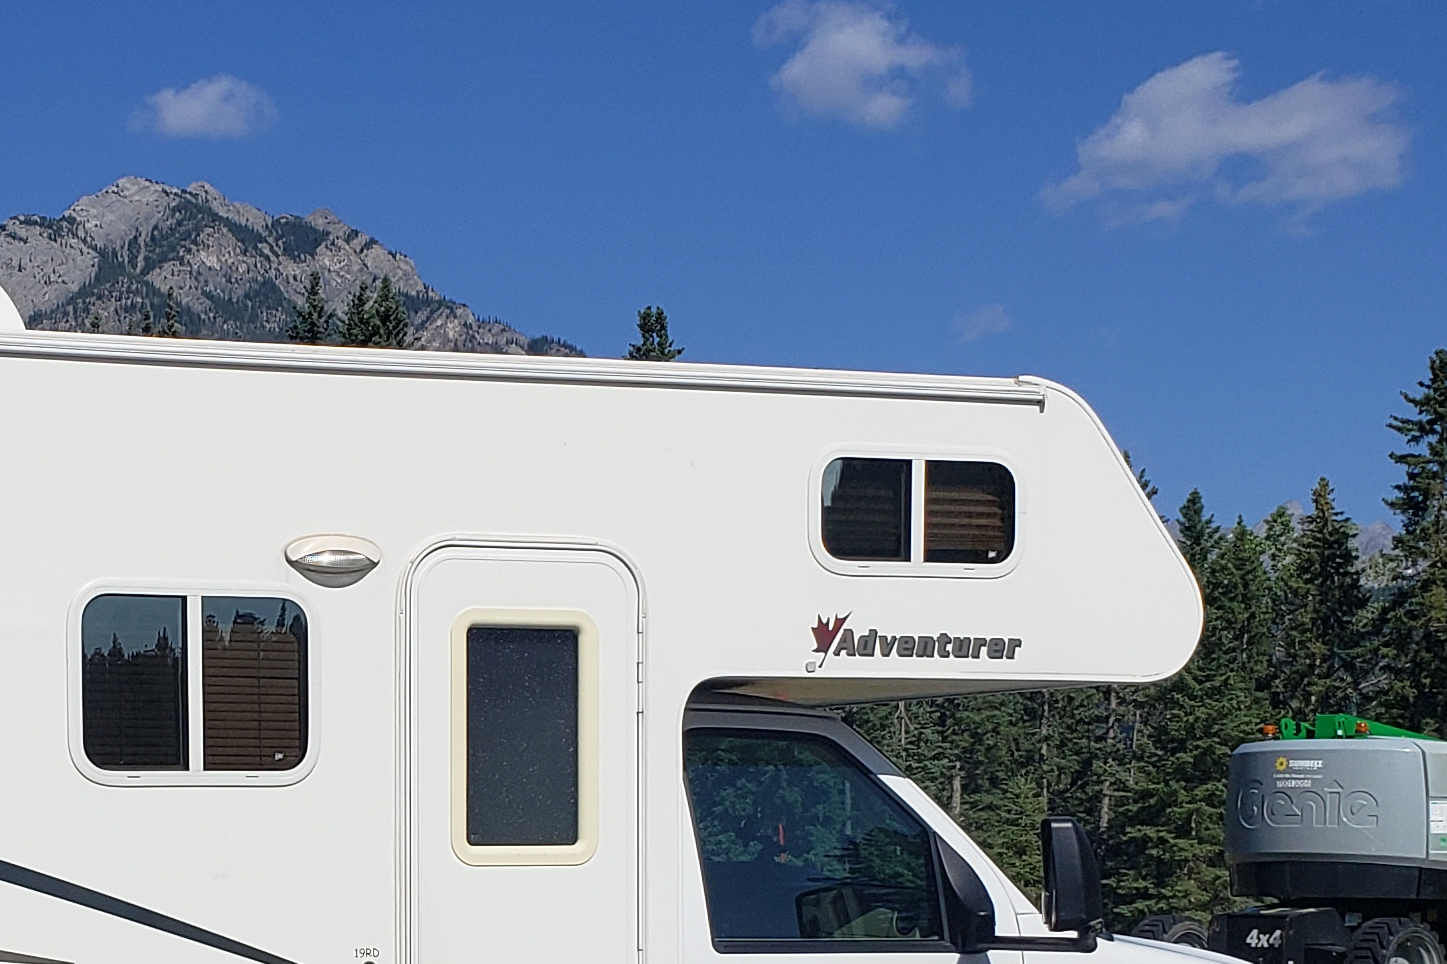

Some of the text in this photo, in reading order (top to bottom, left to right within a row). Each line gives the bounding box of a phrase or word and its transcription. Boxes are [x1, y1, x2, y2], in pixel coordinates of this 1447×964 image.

[833, 628, 1022, 660] Adventurer
[1237, 779, 1379, 829] Genie
[1245, 928, 1282, 948] 4x4
[354, 948, 380, 959] 19RD
